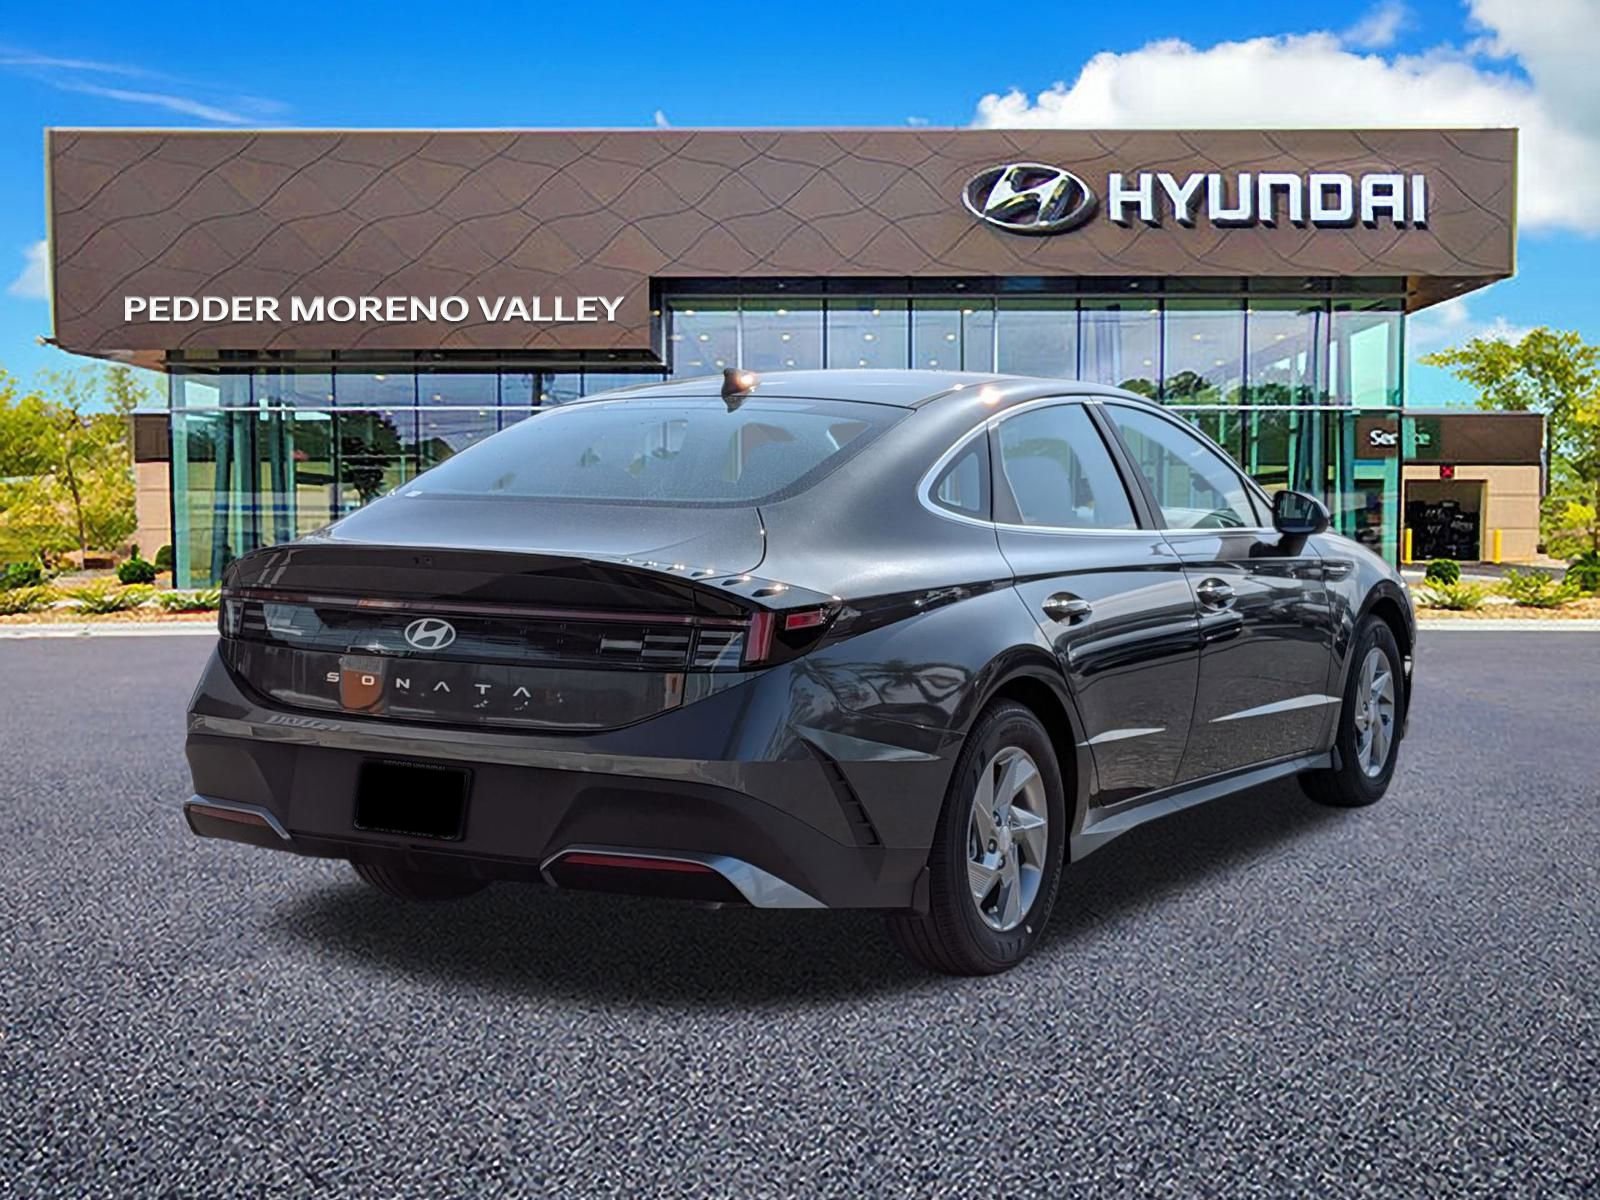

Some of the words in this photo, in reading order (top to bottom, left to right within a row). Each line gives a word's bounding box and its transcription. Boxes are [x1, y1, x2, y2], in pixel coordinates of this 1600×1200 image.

[1108, 172, 1427, 228] HYUNDAI
[123, 295, 281, 322] PEDDER
[290, 295, 470, 322] MORENO
[477, 295, 624, 322] VALLEY
[1369, 428, 1431, 446] Sere
[325, 671, 533, 698] SONATA
